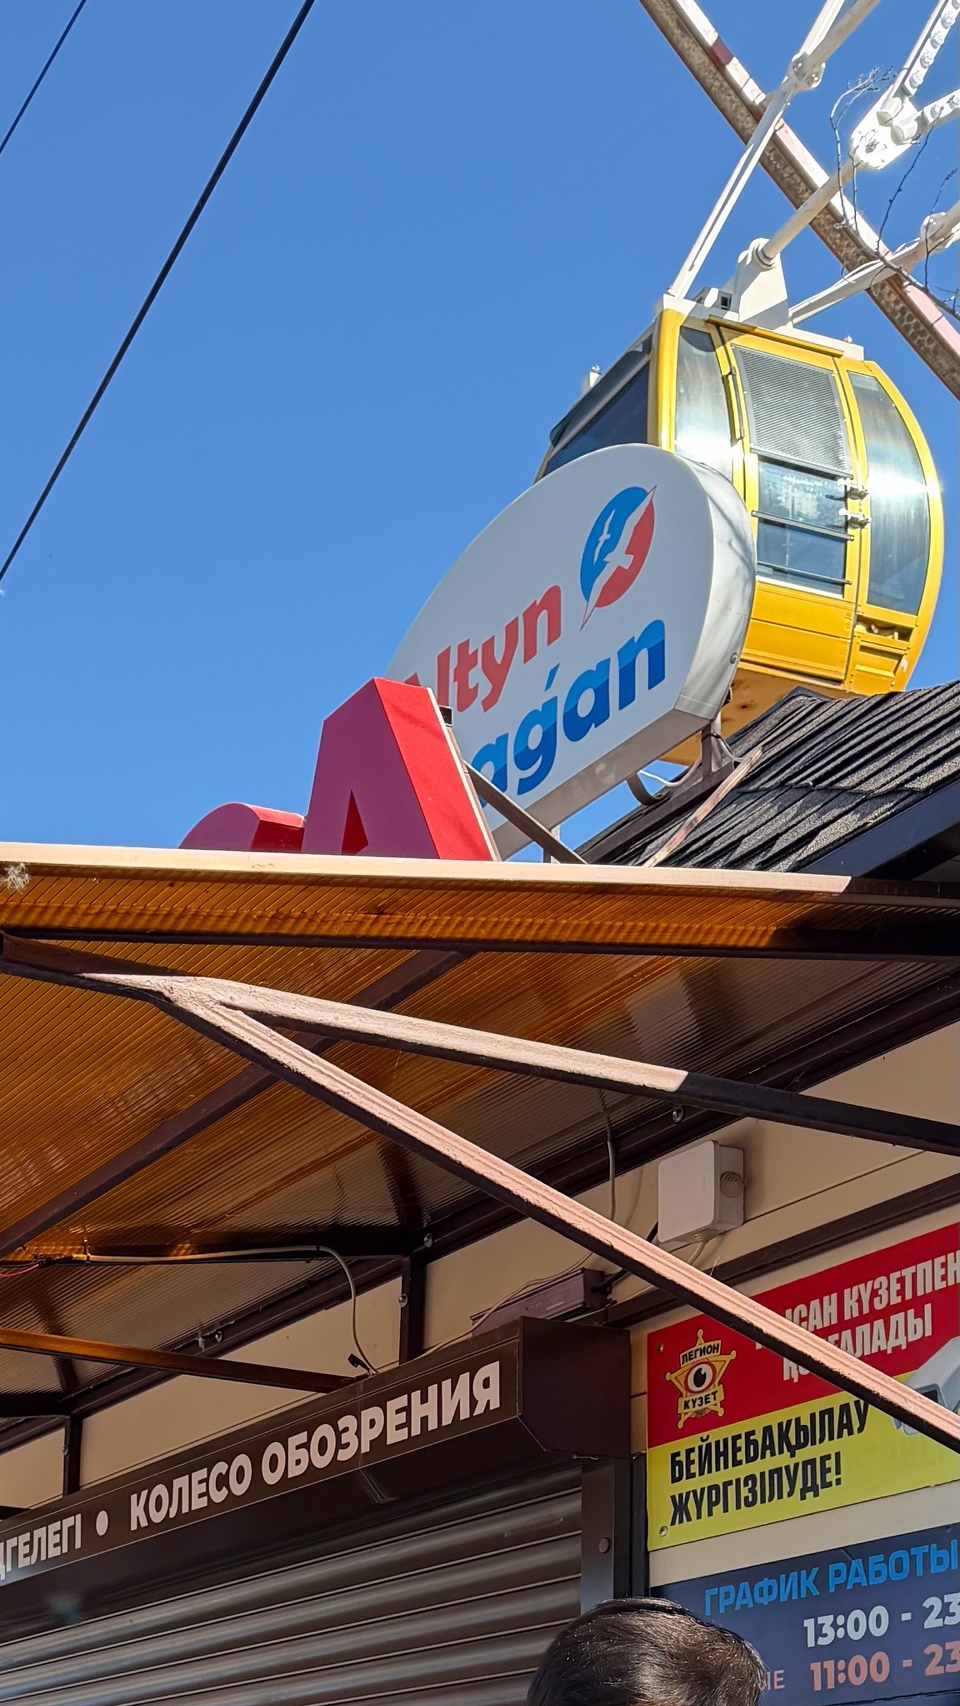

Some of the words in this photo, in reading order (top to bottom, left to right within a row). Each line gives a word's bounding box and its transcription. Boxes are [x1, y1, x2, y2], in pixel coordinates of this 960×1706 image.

[403, 584, 562, 713] ltyn
[681, 1343, 720, 1365] ЛЕГИОН
[130, 1453, 252, 1531] КОЛЕСО
[261, 1360, 501, 1485] ОБОЗРЕНИЯ
[670, 1400, 870, 1485] БЕЙНЕБАҚЫЛАУ
[669, 1451, 842, 1527] ЖҮРГІЗІЛУДЕ!
[704, 1566, 820, 1617] ГРАФИК
[828, 1539, 959, 1593] РАБОТЫ
[803, 1605, 890, 1648] 13:00
[809, 1651, 890, 1692] 11:00
